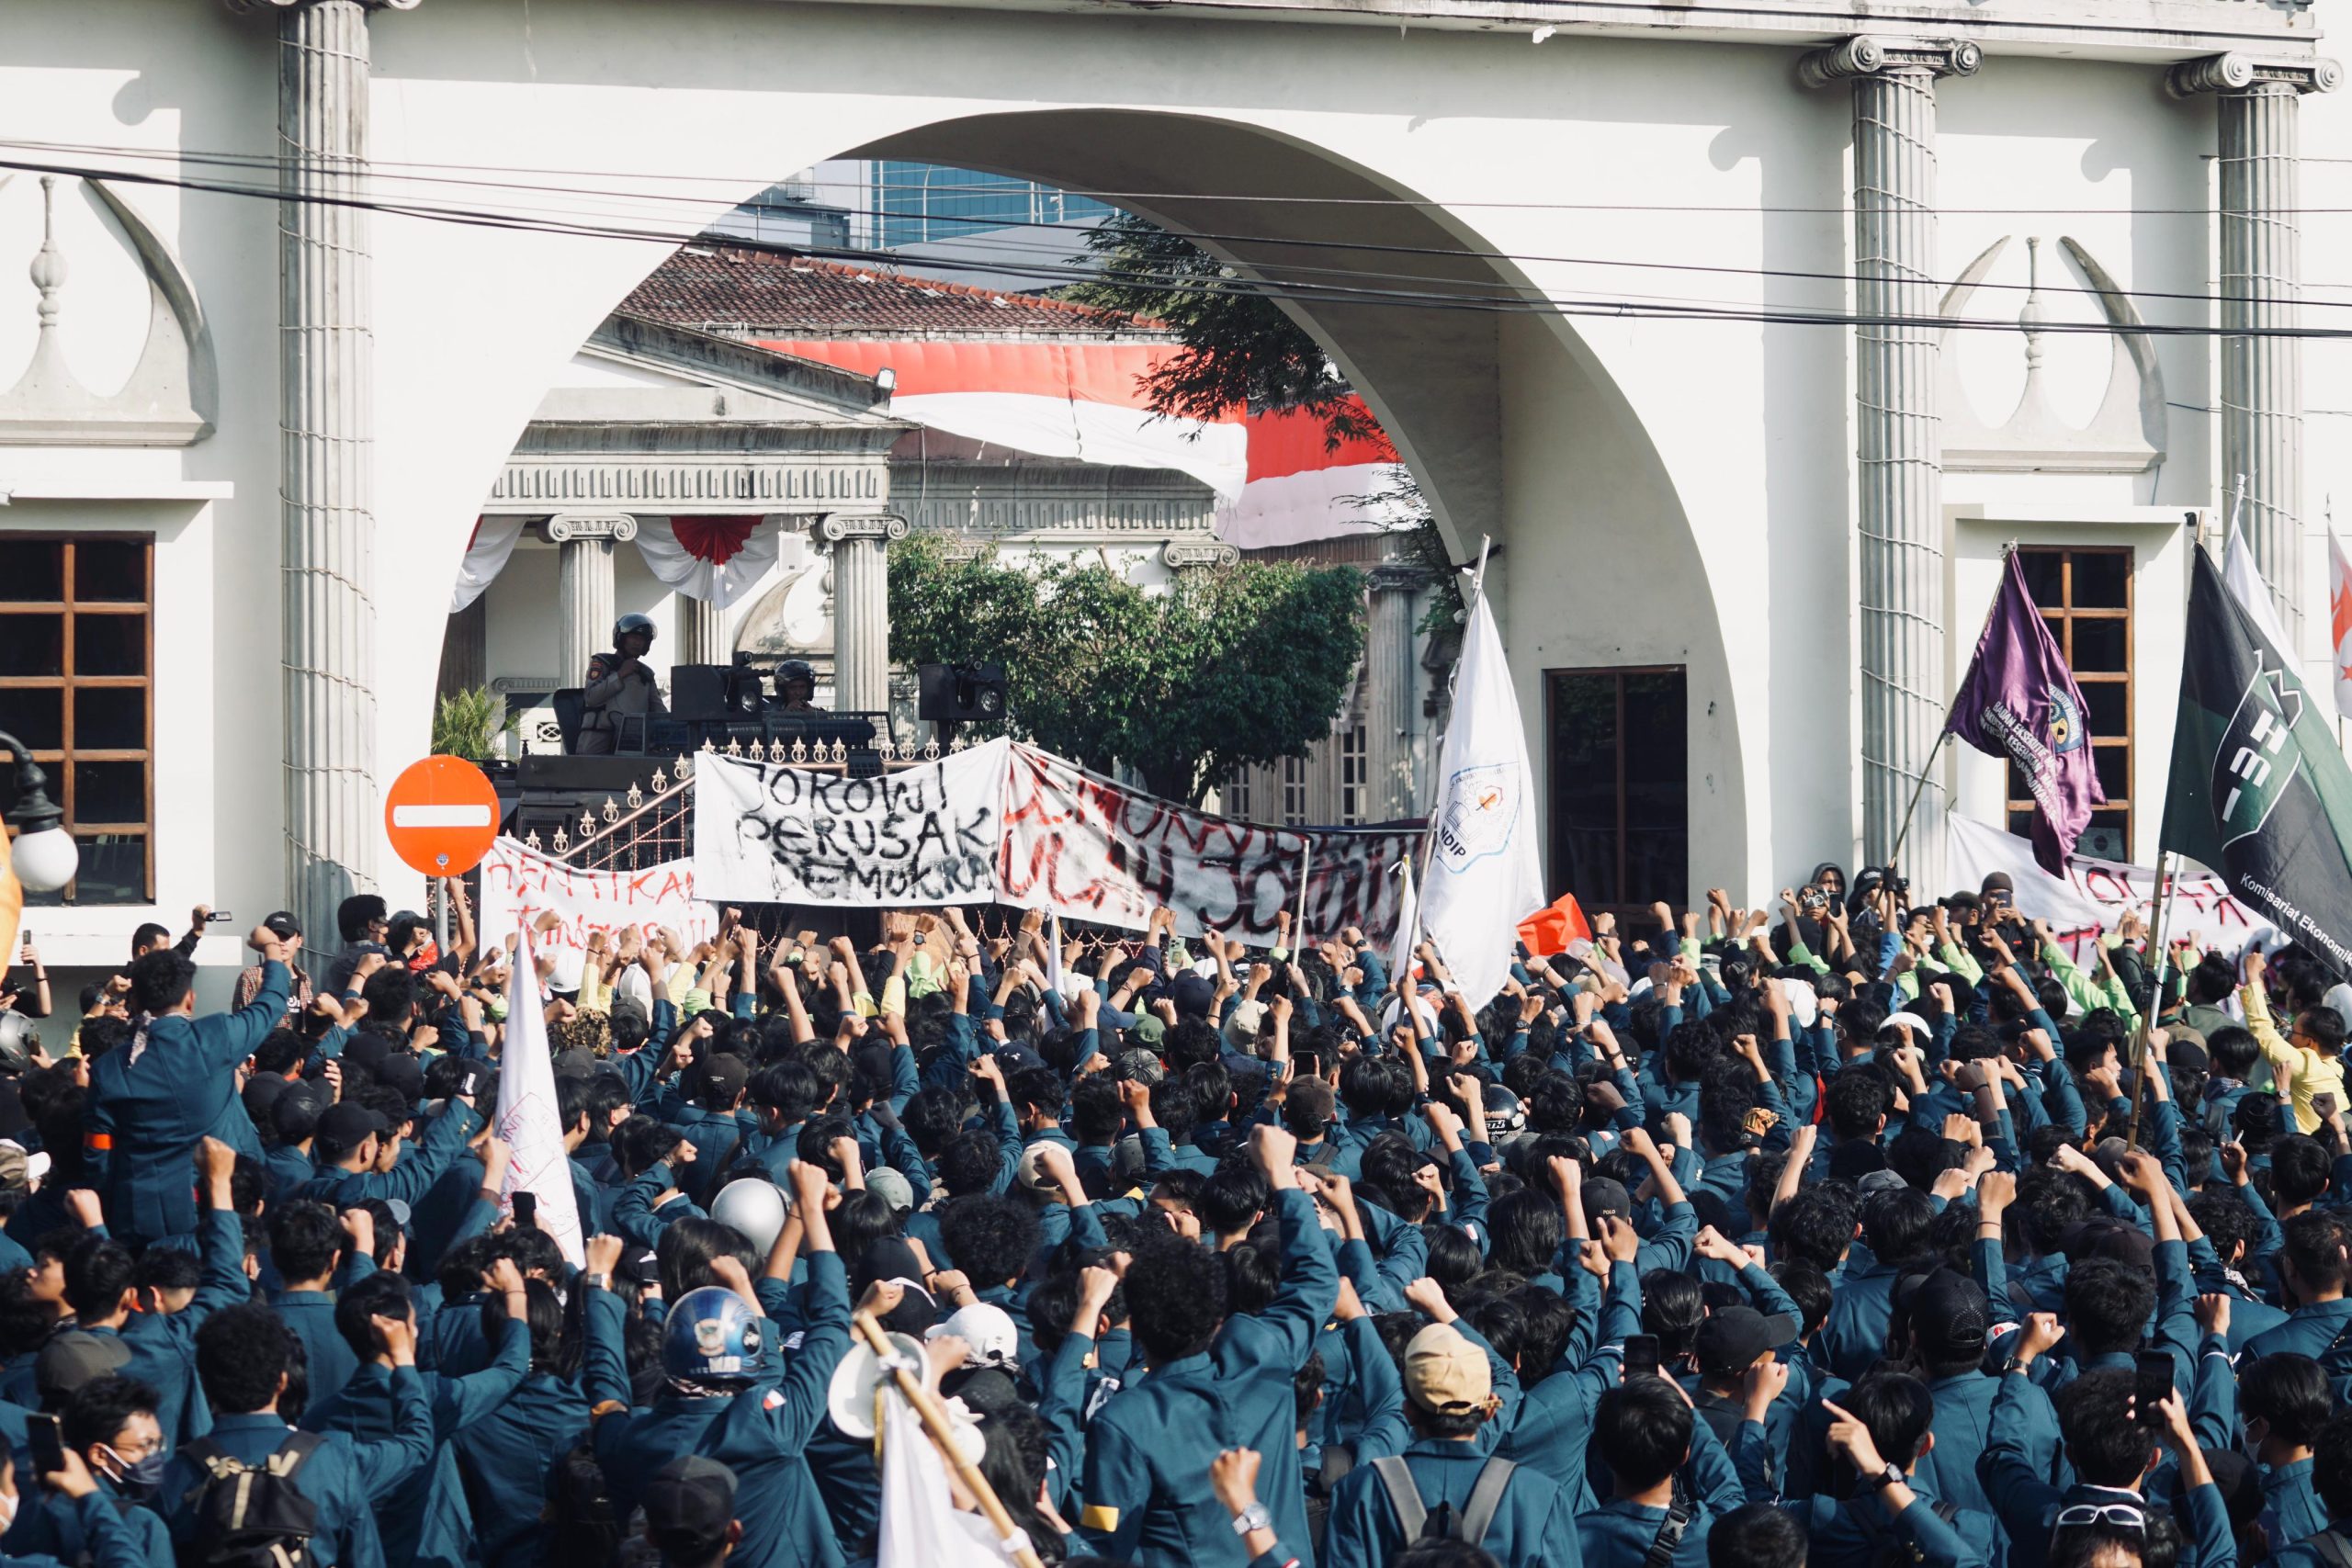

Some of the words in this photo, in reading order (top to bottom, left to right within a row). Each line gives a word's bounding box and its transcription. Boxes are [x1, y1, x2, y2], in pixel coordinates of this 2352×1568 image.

[1992, 700, 2018, 728] BADAN
[2012, 722, 2050, 756] EKSEKUTIF
[2006, 735, 2044, 773] KESEHATAN
[736, 807, 996, 862] PERUSAK
[1441, 823, 1466, 856] NDIP
[2241, 873, 2301, 921] Komisariat
